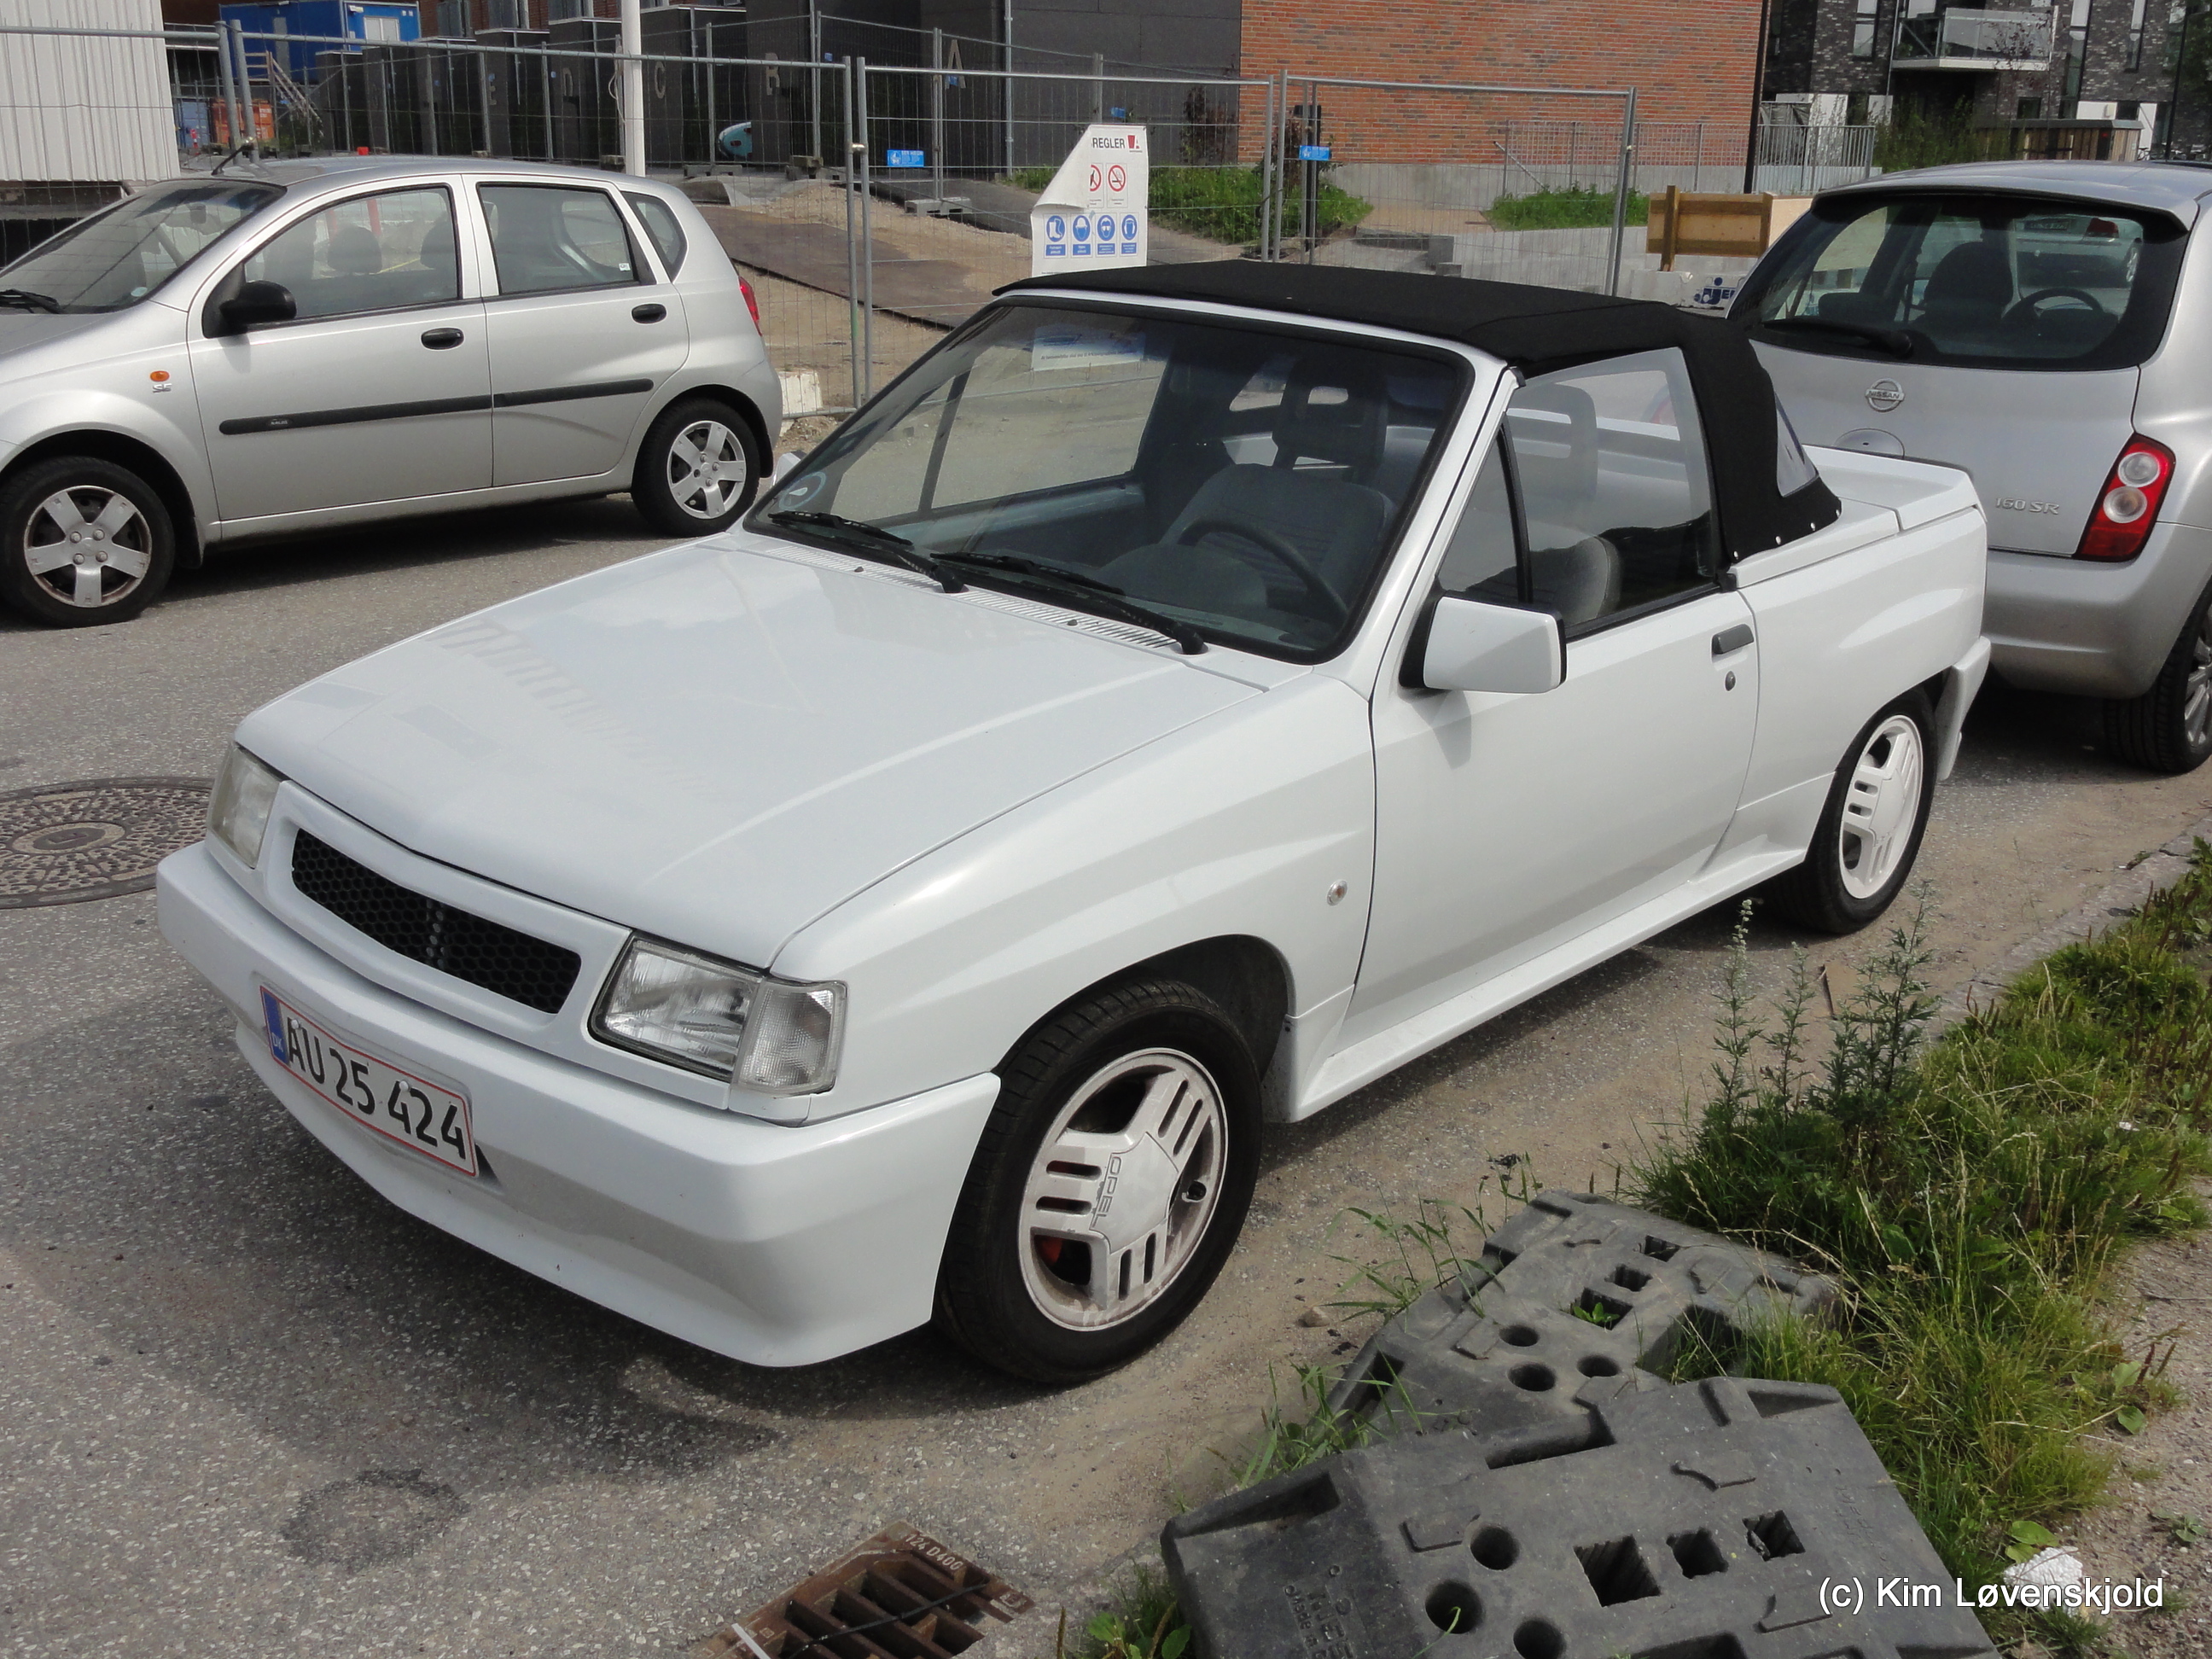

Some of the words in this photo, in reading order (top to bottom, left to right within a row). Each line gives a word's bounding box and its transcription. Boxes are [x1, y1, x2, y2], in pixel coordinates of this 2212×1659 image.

[654, 61, 666, 100] C
[945, 39, 966, 89] A
[1092, 137, 1126, 148] REGLER
[1868, 390, 1900, 399] NISSAN
[1995, 498, 2026, 510] 160
[2029, 501, 2060, 515] SR
[271, 1032, 284, 1053] DK
[288, 1016, 325, 1085] AU
[329, 1047, 375, 1115] 25
[387, 1080, 466, 1161] 424
[1092, 1156, 1122, 1228] OPEL
[905, 1534, 930, 1551] 124
[926, 1545, 964, 1571] D400
